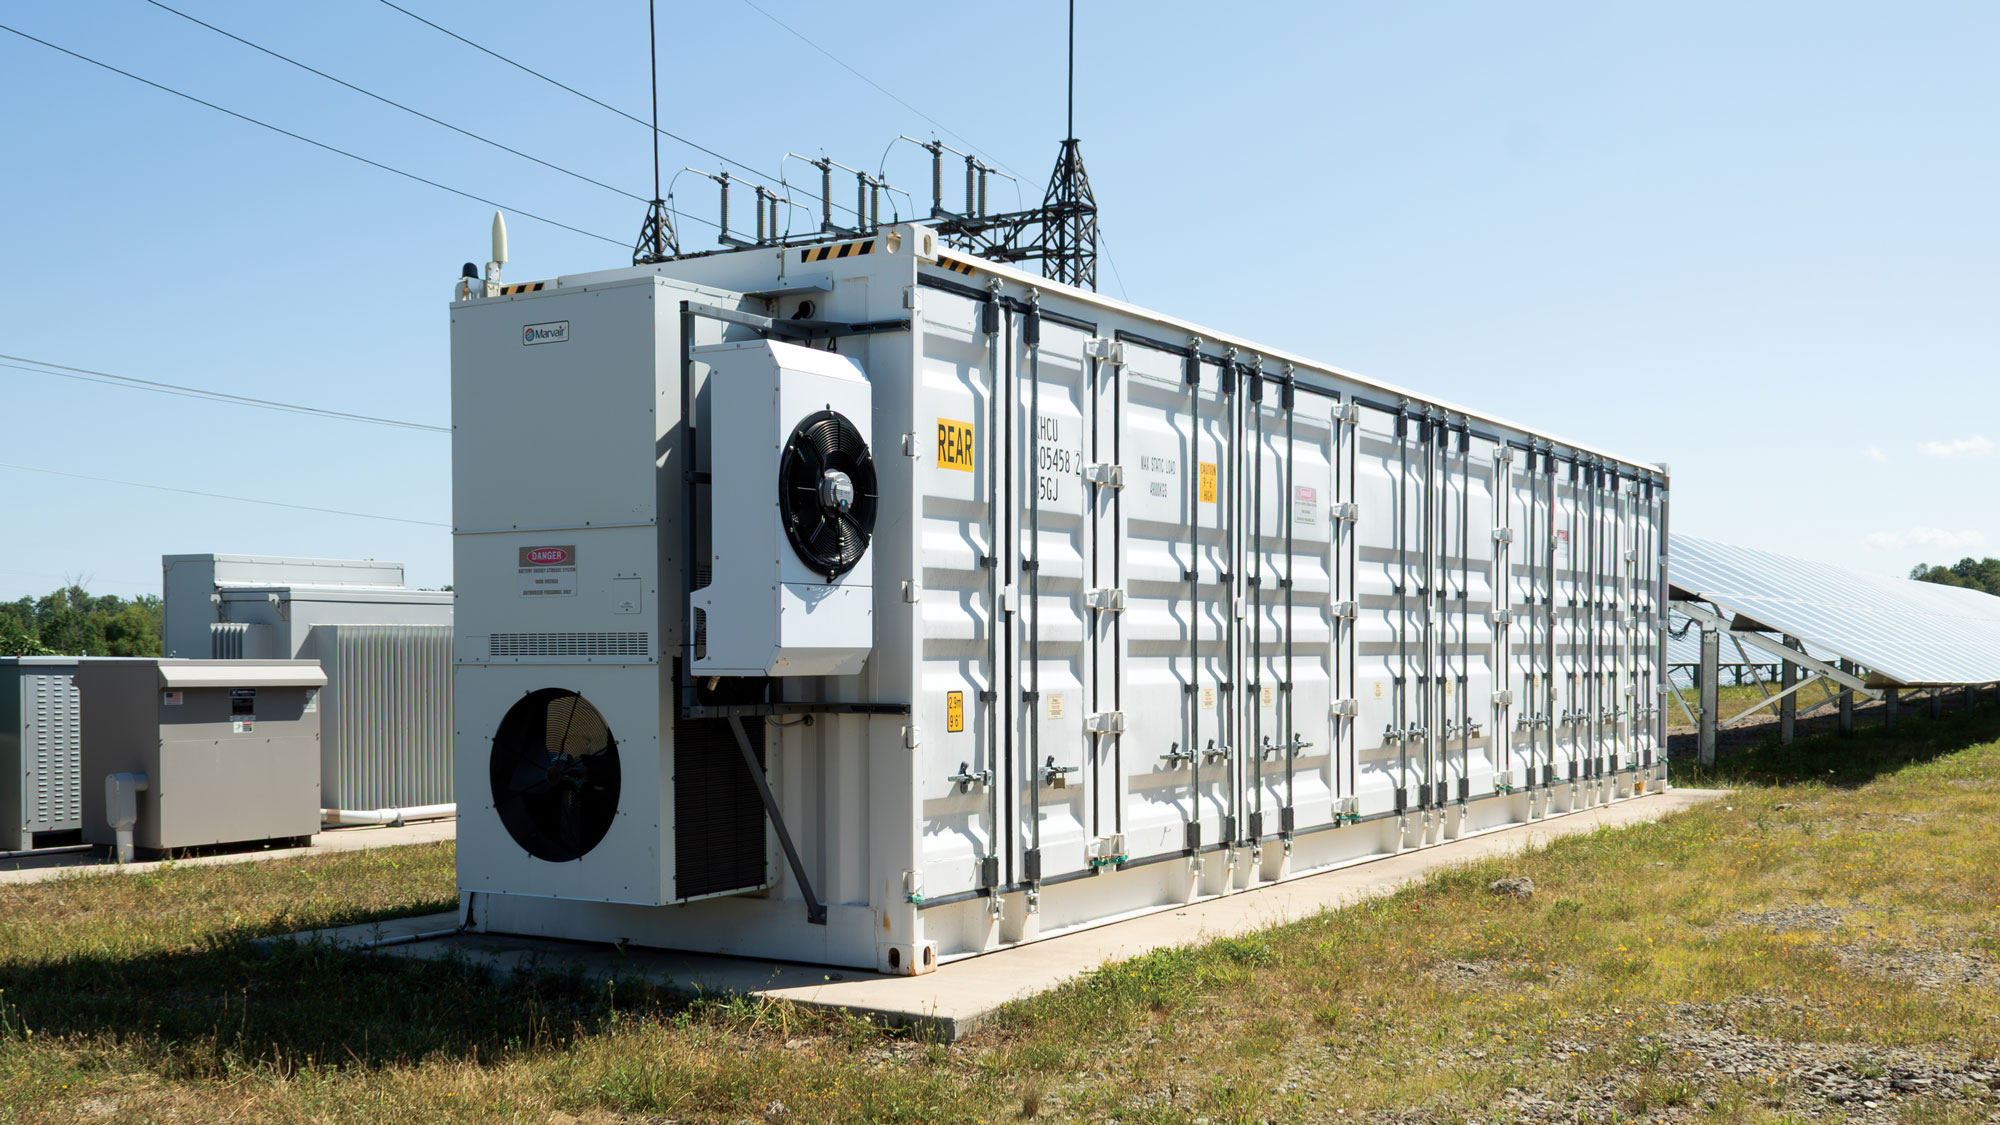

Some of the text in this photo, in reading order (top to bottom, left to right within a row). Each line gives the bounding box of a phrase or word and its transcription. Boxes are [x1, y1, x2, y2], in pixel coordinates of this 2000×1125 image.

[535, 325, 565, 339] Marvair
[1037, 416, 1058, 442] HCU
[937, 423, 973, 466] REAR
[1037, 446, 1081, 475] 05458 2
[1165, 459, 1176, 475] LOAD
[1037, 476, 1058, 501] 5GJ
[532, 551, 561, 560] DANGER
